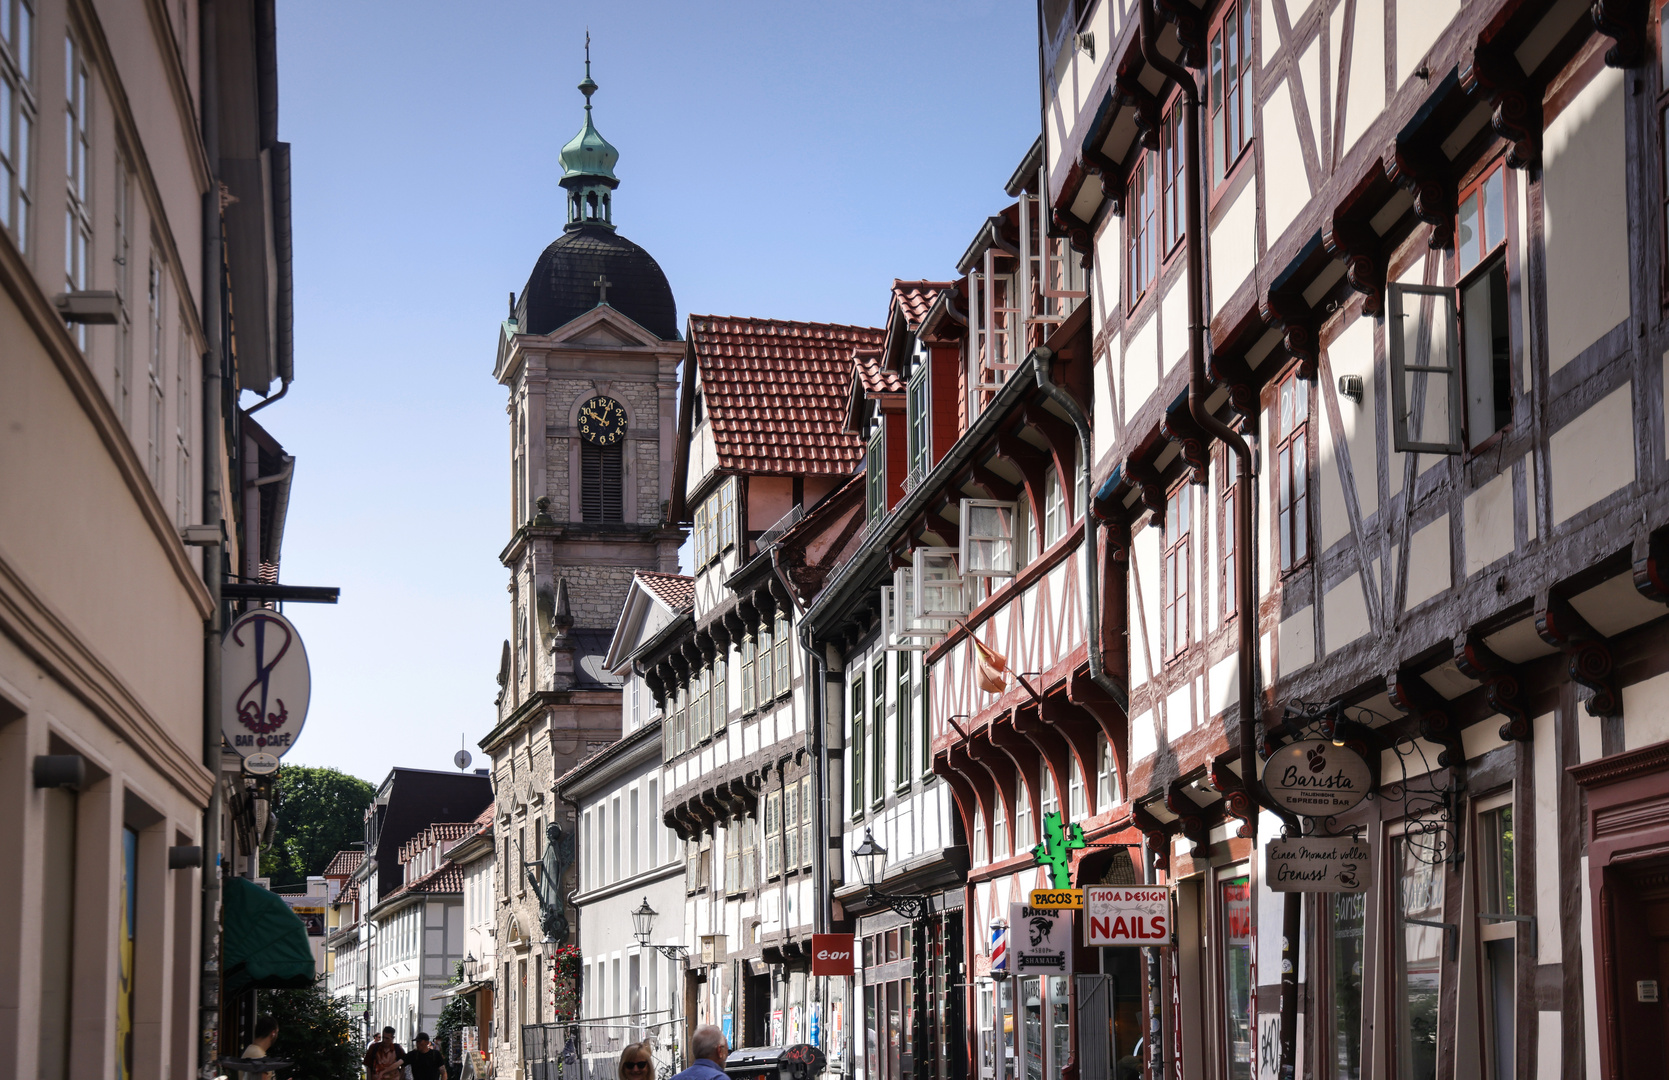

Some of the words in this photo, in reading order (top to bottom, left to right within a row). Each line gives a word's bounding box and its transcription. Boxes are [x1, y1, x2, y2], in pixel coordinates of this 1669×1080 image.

[590, 400, 596, 408] 11
[580, 416, 588, 424] 9
[618, 418, 624, 426] 3
[583, 425, 590, 434] 8
[615, 427, 621, 435] 4
[590, 432, 596, 442] 7
[600, 436, 606, 444] 6
[608, 432, 614, 440] 5
[235, 735, 254, 746] BAR
[1281, 765, 1354, 788] Barista
[1271, 846, 1296, 860] Einen
[1298, 846, 1337, 861] Moment
[1340, 847, 1368, 860] voller
[1278, 863, 1328, 882] Genuss!
[1034, 893, 1072, 904] PACO'S
[1090, 892, 1122, 902] THOA
[1125, 891, 1166, 902] DESIGN
[1022, 906, 1059, 918] BARBER
[1090, 916, 1166, 939] NAILS
[1056, 981, 1066, 996] SHOP
